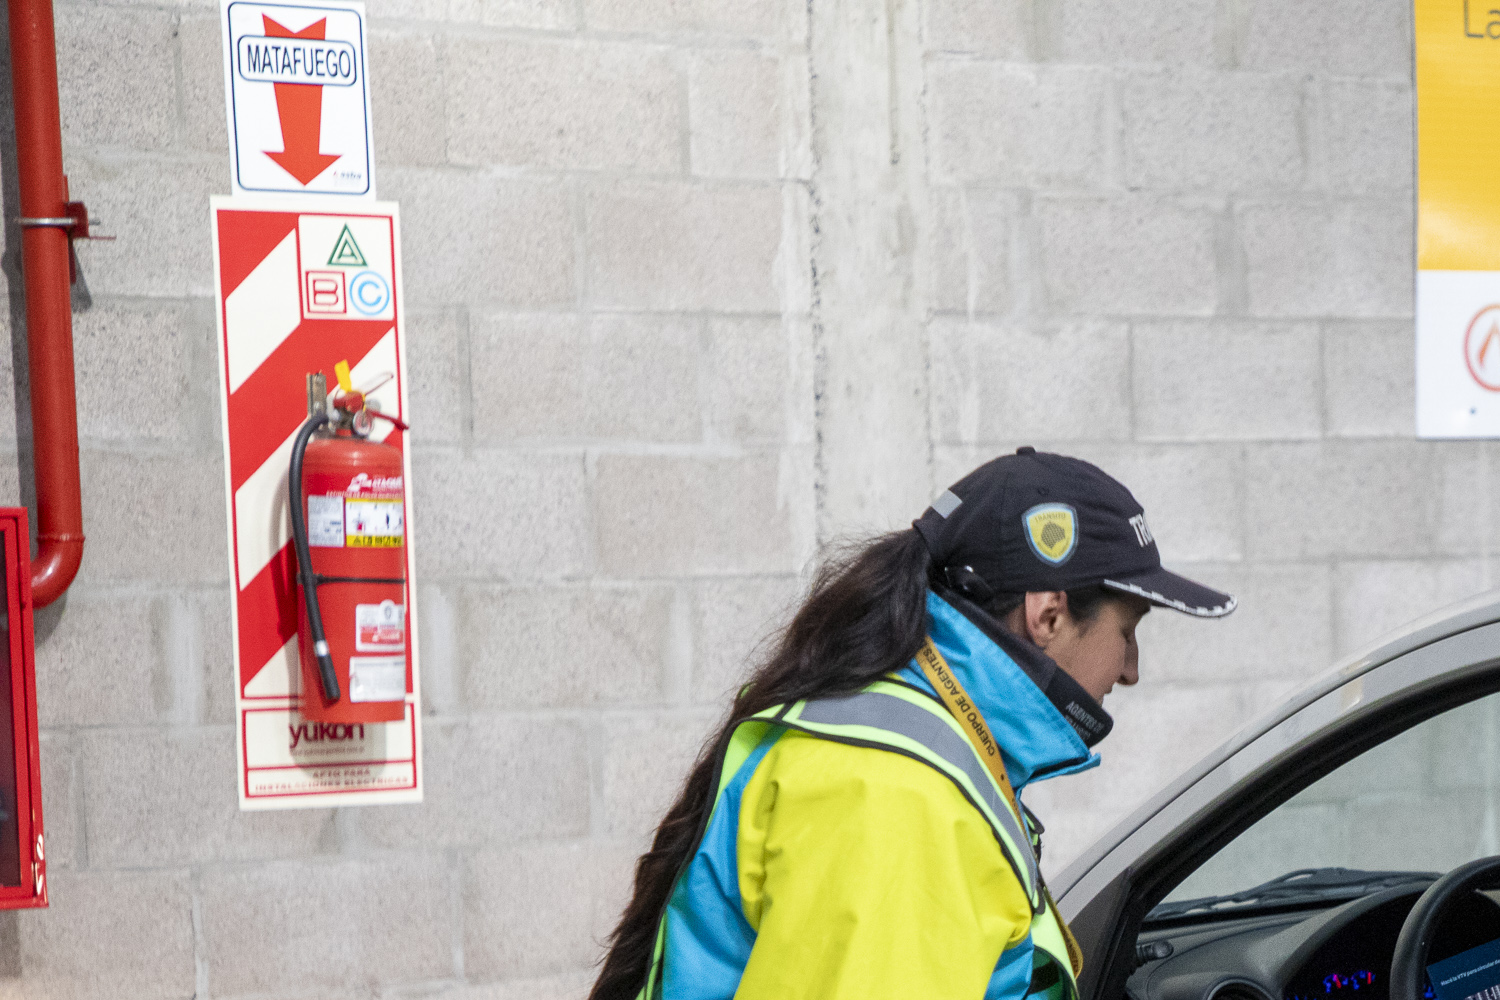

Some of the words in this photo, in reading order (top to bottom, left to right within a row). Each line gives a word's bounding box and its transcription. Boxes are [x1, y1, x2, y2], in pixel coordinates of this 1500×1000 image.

[246, 44, 351, 78] MATAFUEGO
[922, 647, 959, 696] AGENTES
[954, 695, 971, 713] DE
[1065, 701, 1098, 729] AGENTES
[289, 723, 364, 749] yukon
[966, 711, 995, 756] CUERPO
